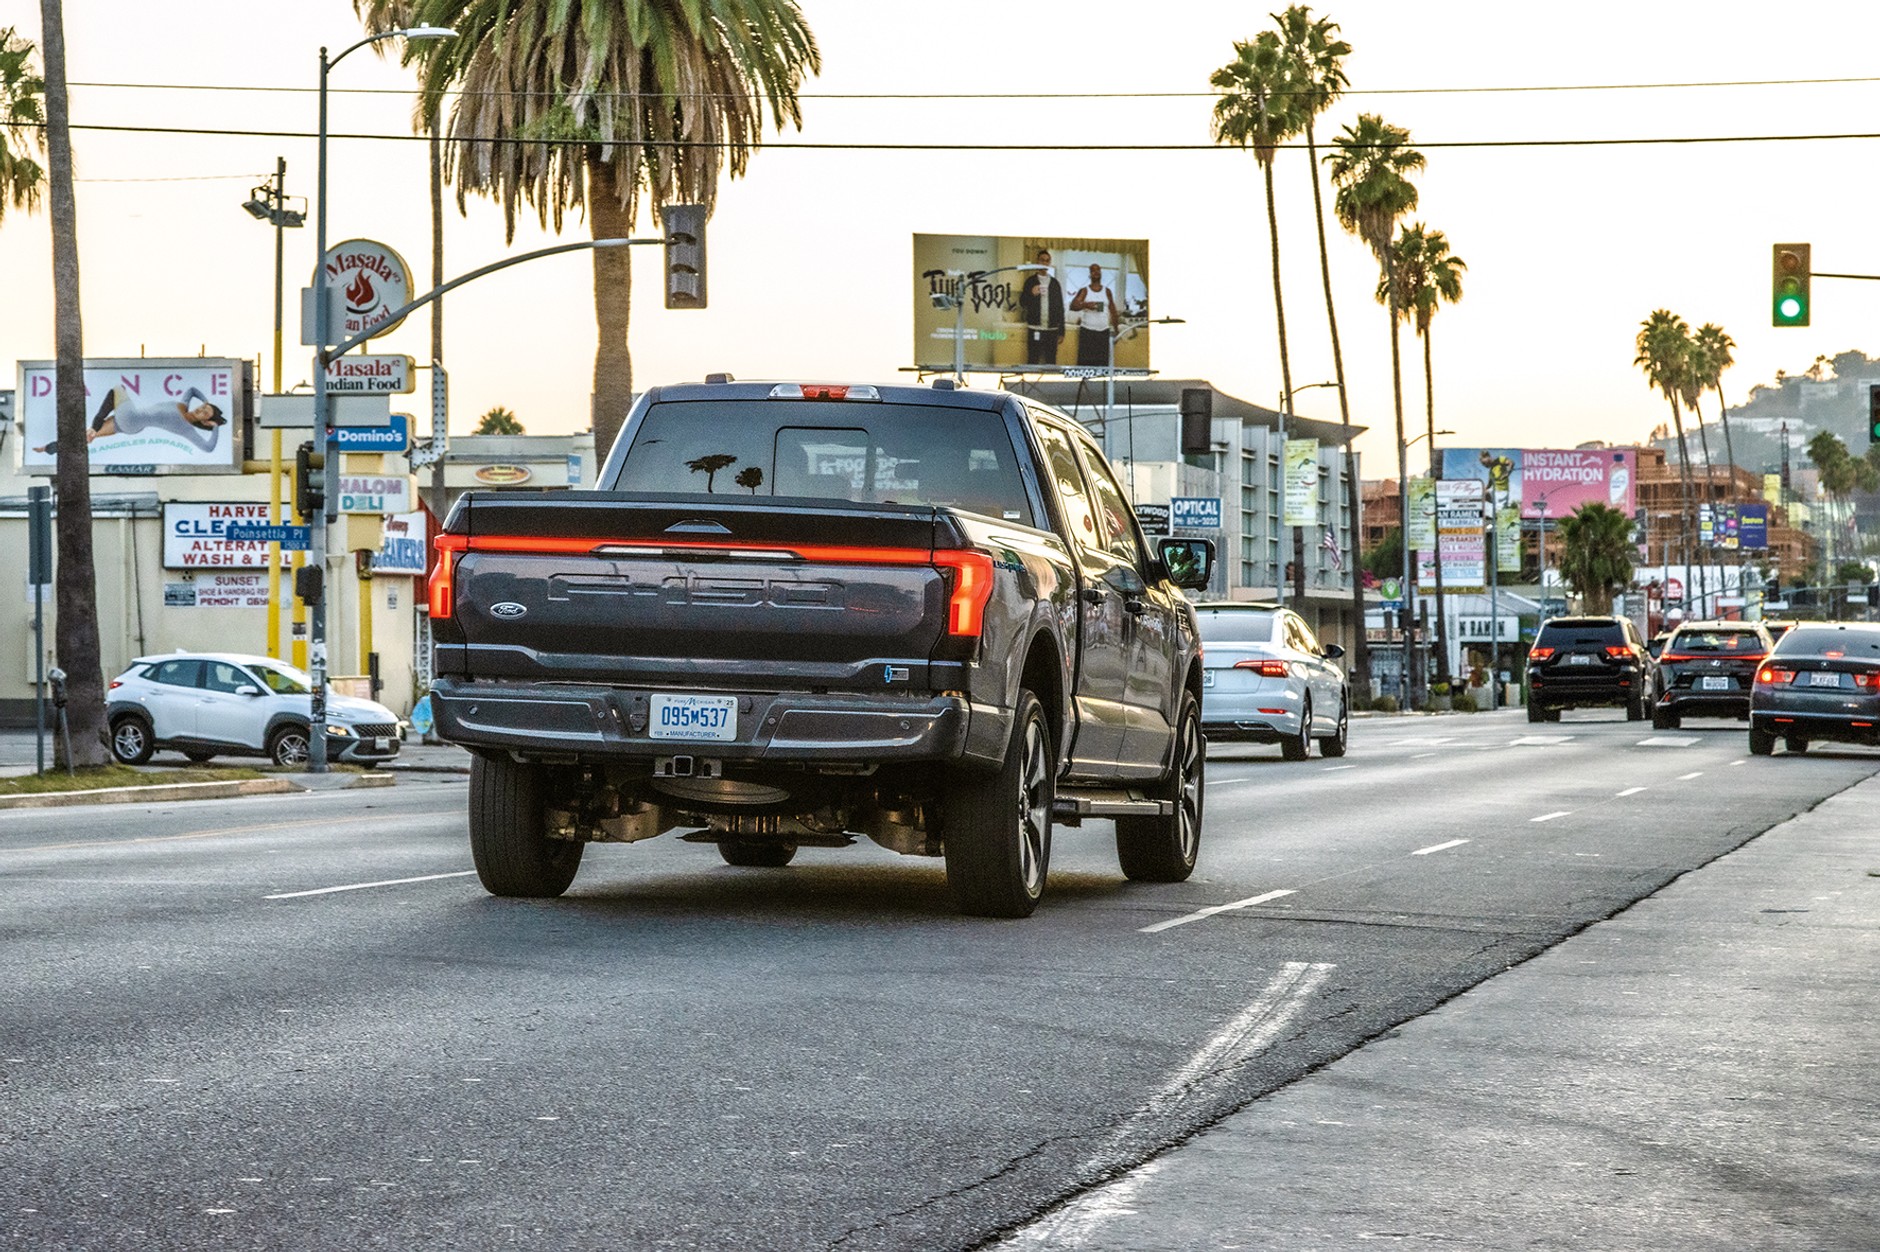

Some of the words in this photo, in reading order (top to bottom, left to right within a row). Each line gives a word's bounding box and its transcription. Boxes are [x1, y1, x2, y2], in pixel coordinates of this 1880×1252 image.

[326, 252, 393, 282] Masala
[967, 270, 1017, 314] Fool
[325, 360, 392, 377] Masala
[32, 374, 228, 398] DNCE
[326, 378, 364, 390] ndian
[368, 378, 401, 390] Food
[338, 430, 403, 442] Domino's
[1524, 453, 1583, 466] INSTANT
[1524, 468, 1604, 480] HYDRATION
[338, 479, 402, 494] HALOM
[342, 495, 384, 510] DELI
[1174, 501, 1218, 515] OPTICAL
[209, 506, 270, 518] HARVE
[234, 528, 286, 539] Poinsettia
[192, 541, 267, 551] ALTERAT
[183, 554, 234, 564] WASH
[242, 554, 252, 564] &
[260, 554, 292, 564] FL
[215, 576, 260, 586] SUNSET
[198, 588, 216, 596] SHOE
[223, 588, 255, 596] HANDBAG
[257, 588, 269, 596] REP
[498, 605, 518, 615] Ford
[1470, 620, 1505, 637] RAMN
[662, 706, 728, 728] 095M537
[670, 730, 716, 738] MANUFACTURER
